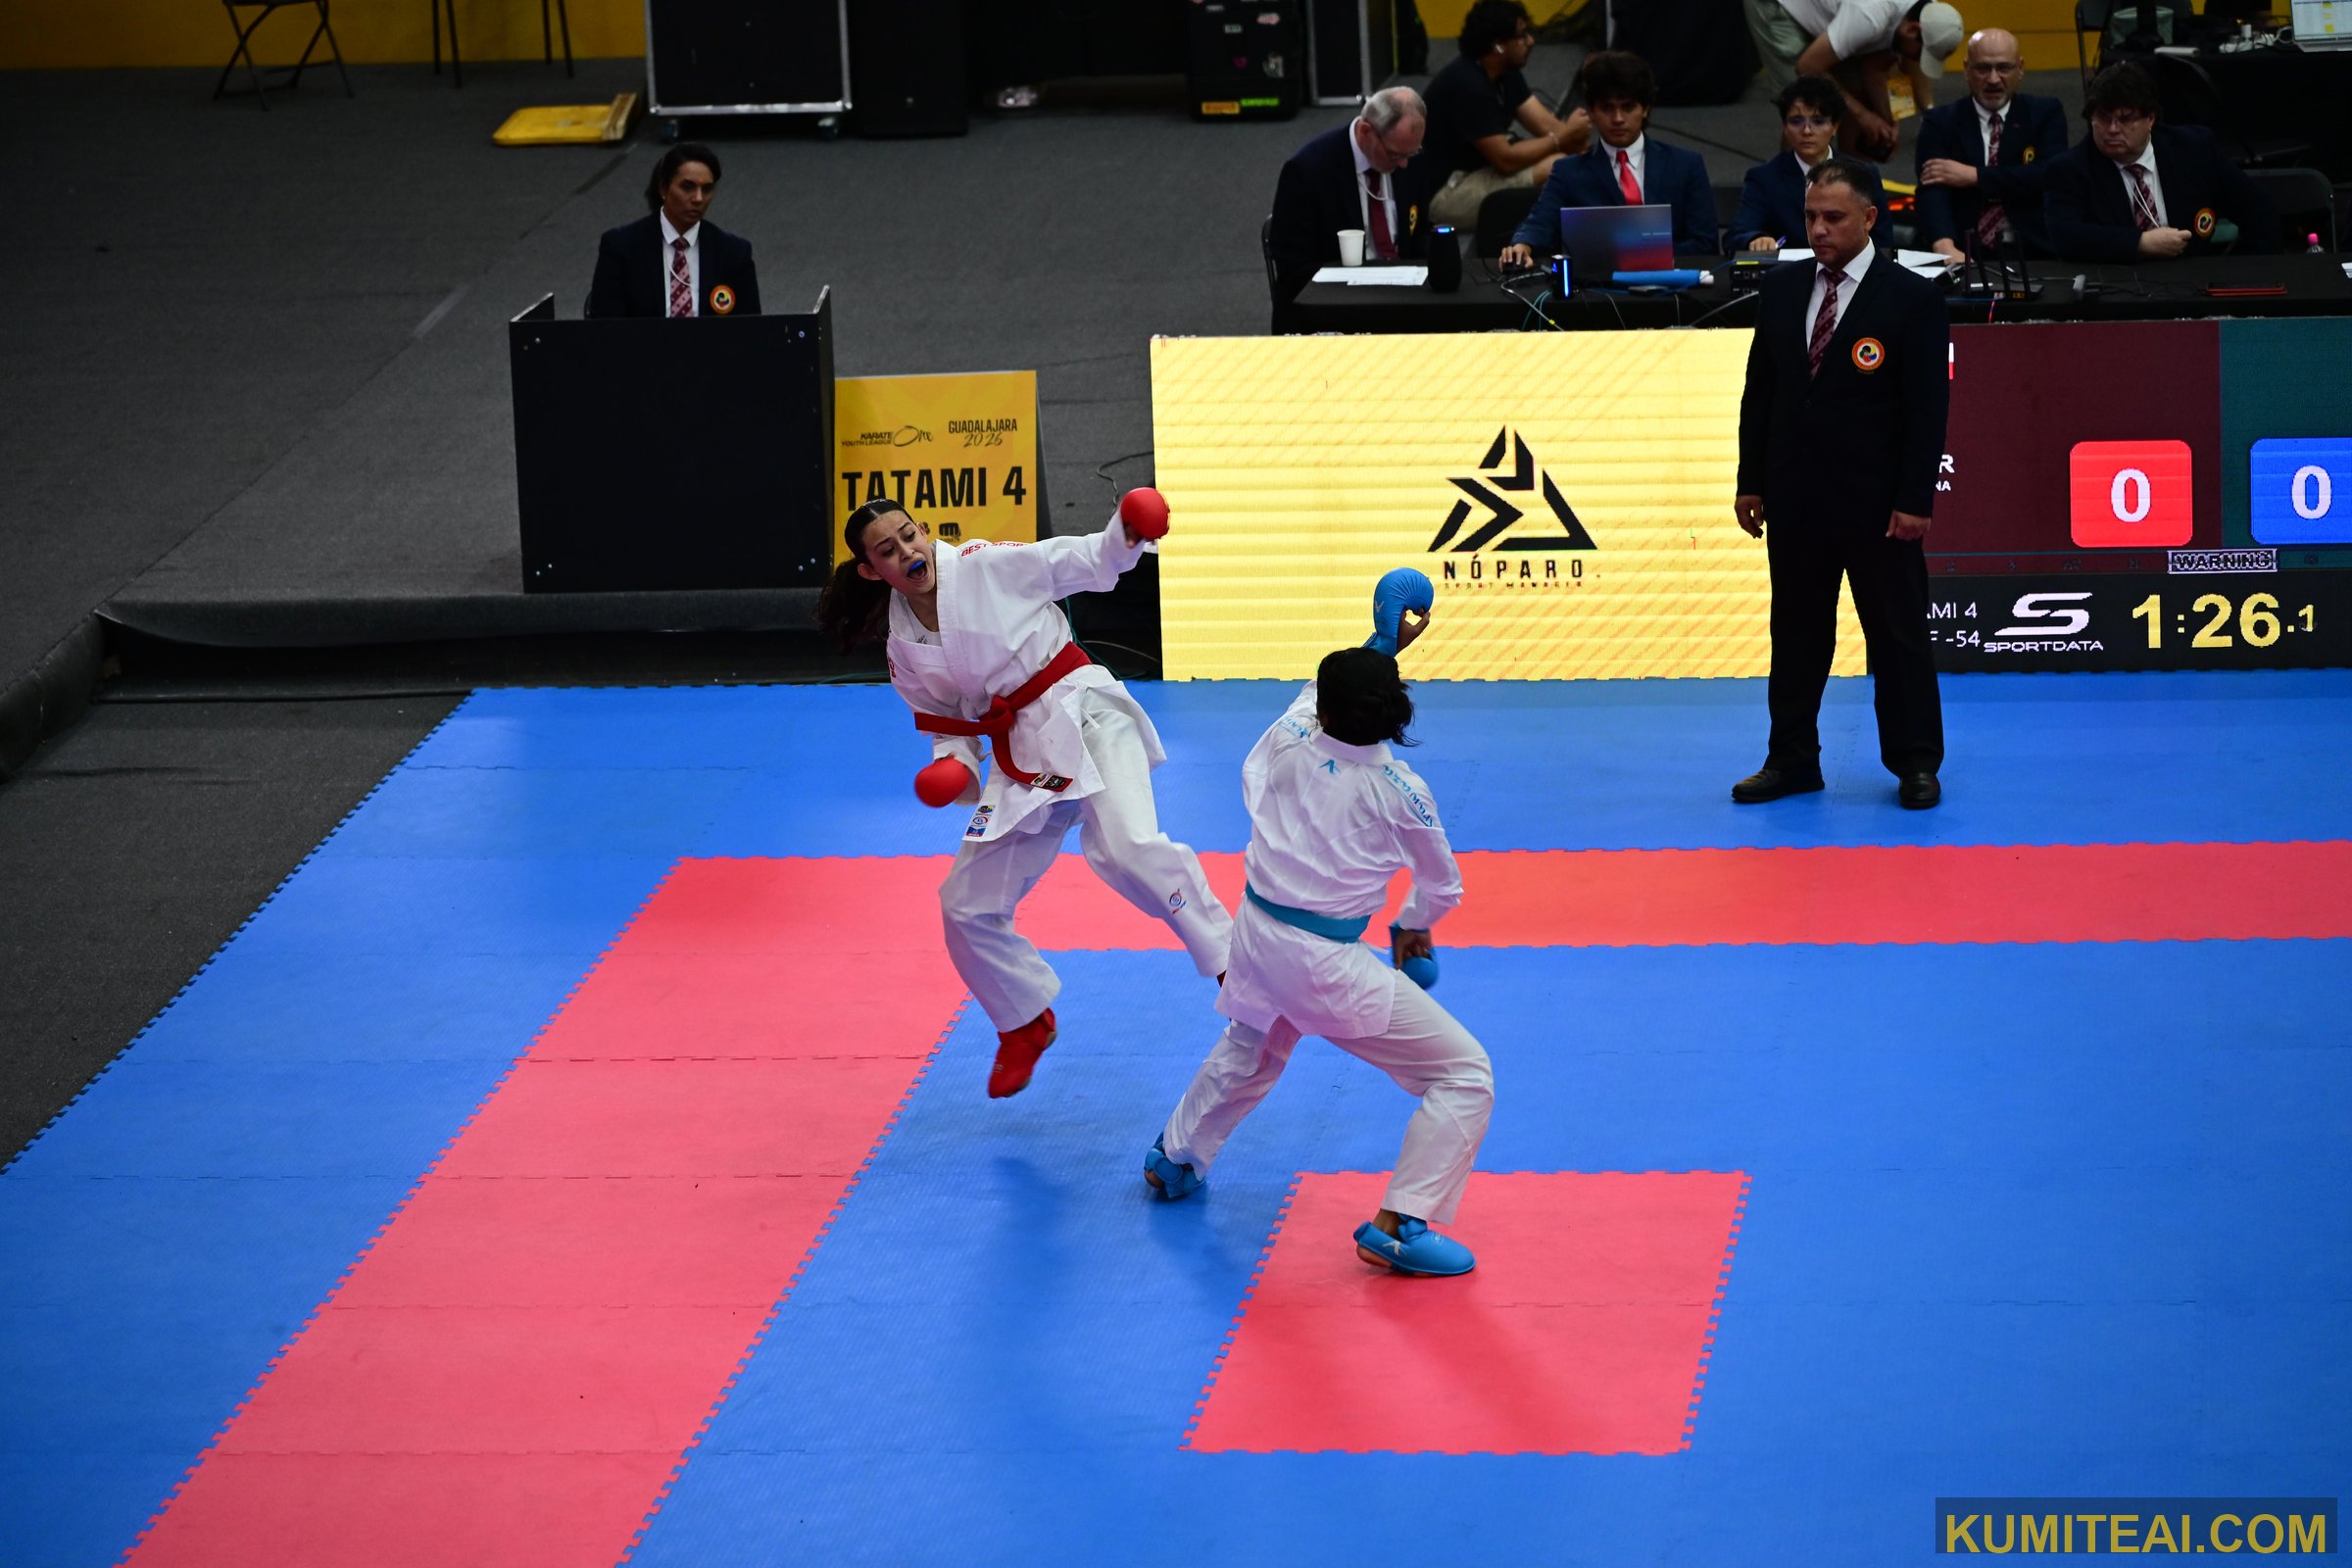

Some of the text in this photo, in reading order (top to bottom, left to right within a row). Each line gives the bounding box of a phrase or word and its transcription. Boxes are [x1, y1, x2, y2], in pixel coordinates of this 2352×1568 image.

[949, 418, 1017, 434] GUADALAJARA
[860, 431, 893, 440] KARATE
[963, 431, 1003, 448] 2026
[842, 466, 1026, 511] TATAMI 4
[2110, 467, 2151, 522] 0
[2291, 466, 2331, 519] 0
[960, 543, 988, 557] BEST
[2175, 552, 2271, 570] WARNING
[1927, 601, 1978, 619] MI 4
[1945, 630, 1981, 647] -54
[1984, 640, 2104, 653] SPORTDATA
